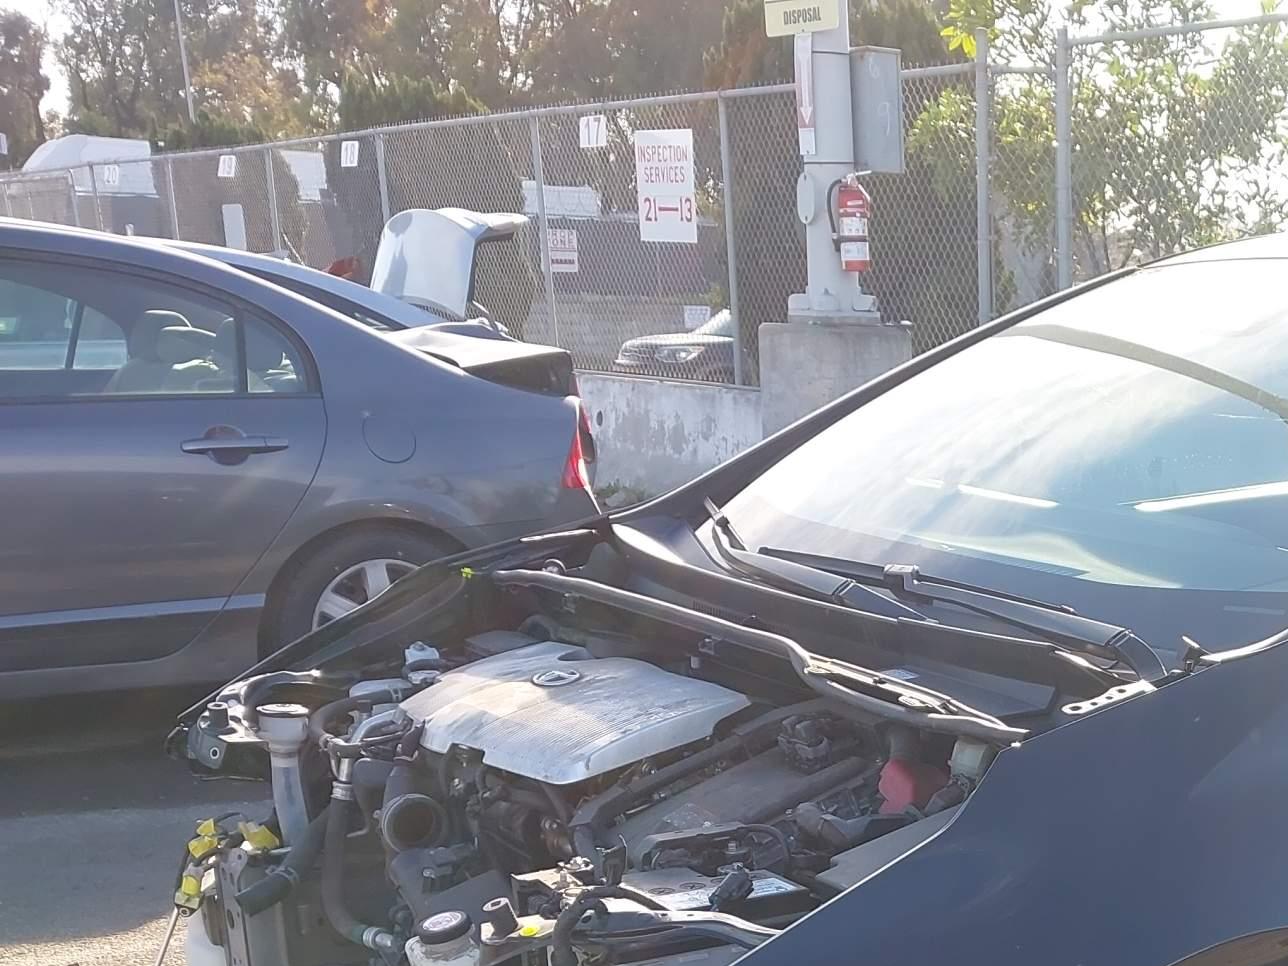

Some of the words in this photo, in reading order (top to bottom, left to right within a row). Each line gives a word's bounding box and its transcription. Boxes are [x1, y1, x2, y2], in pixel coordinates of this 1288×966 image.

[783, 6, 821, 26] DISPOSAL
[584, 116, 601, 146] 17
[344, 143, 356, 164] 18
[637, 145, 688, 162] INSPECTION
[105, 165, 119, 184] 20
[644, 166, 685, 183] SERVICES
